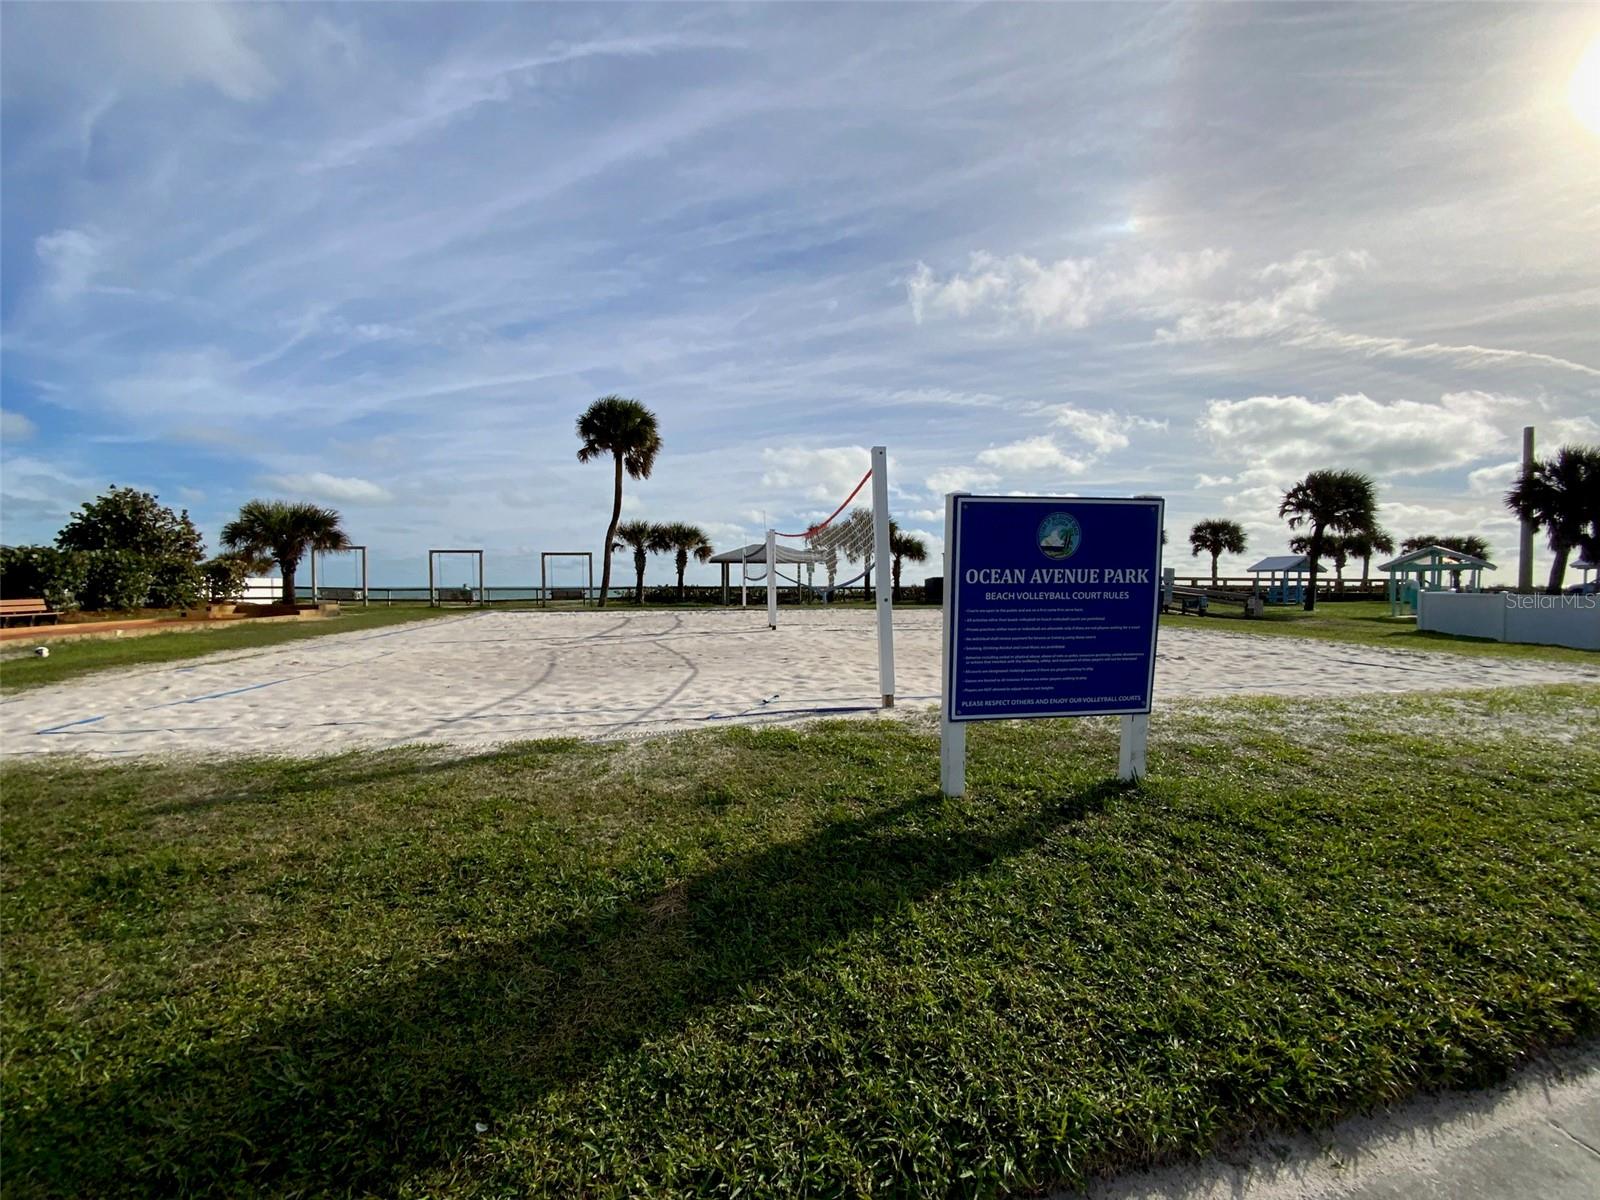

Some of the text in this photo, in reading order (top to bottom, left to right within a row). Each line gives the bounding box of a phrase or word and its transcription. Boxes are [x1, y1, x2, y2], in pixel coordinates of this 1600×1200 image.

[965, 568, 1150, 585] OCEAN AVENUE PARK
[985, 591, 1130, 601] BEACH VOLLEYBALL COURT RULES
[984, 699, 1010, 707] RESPECT
